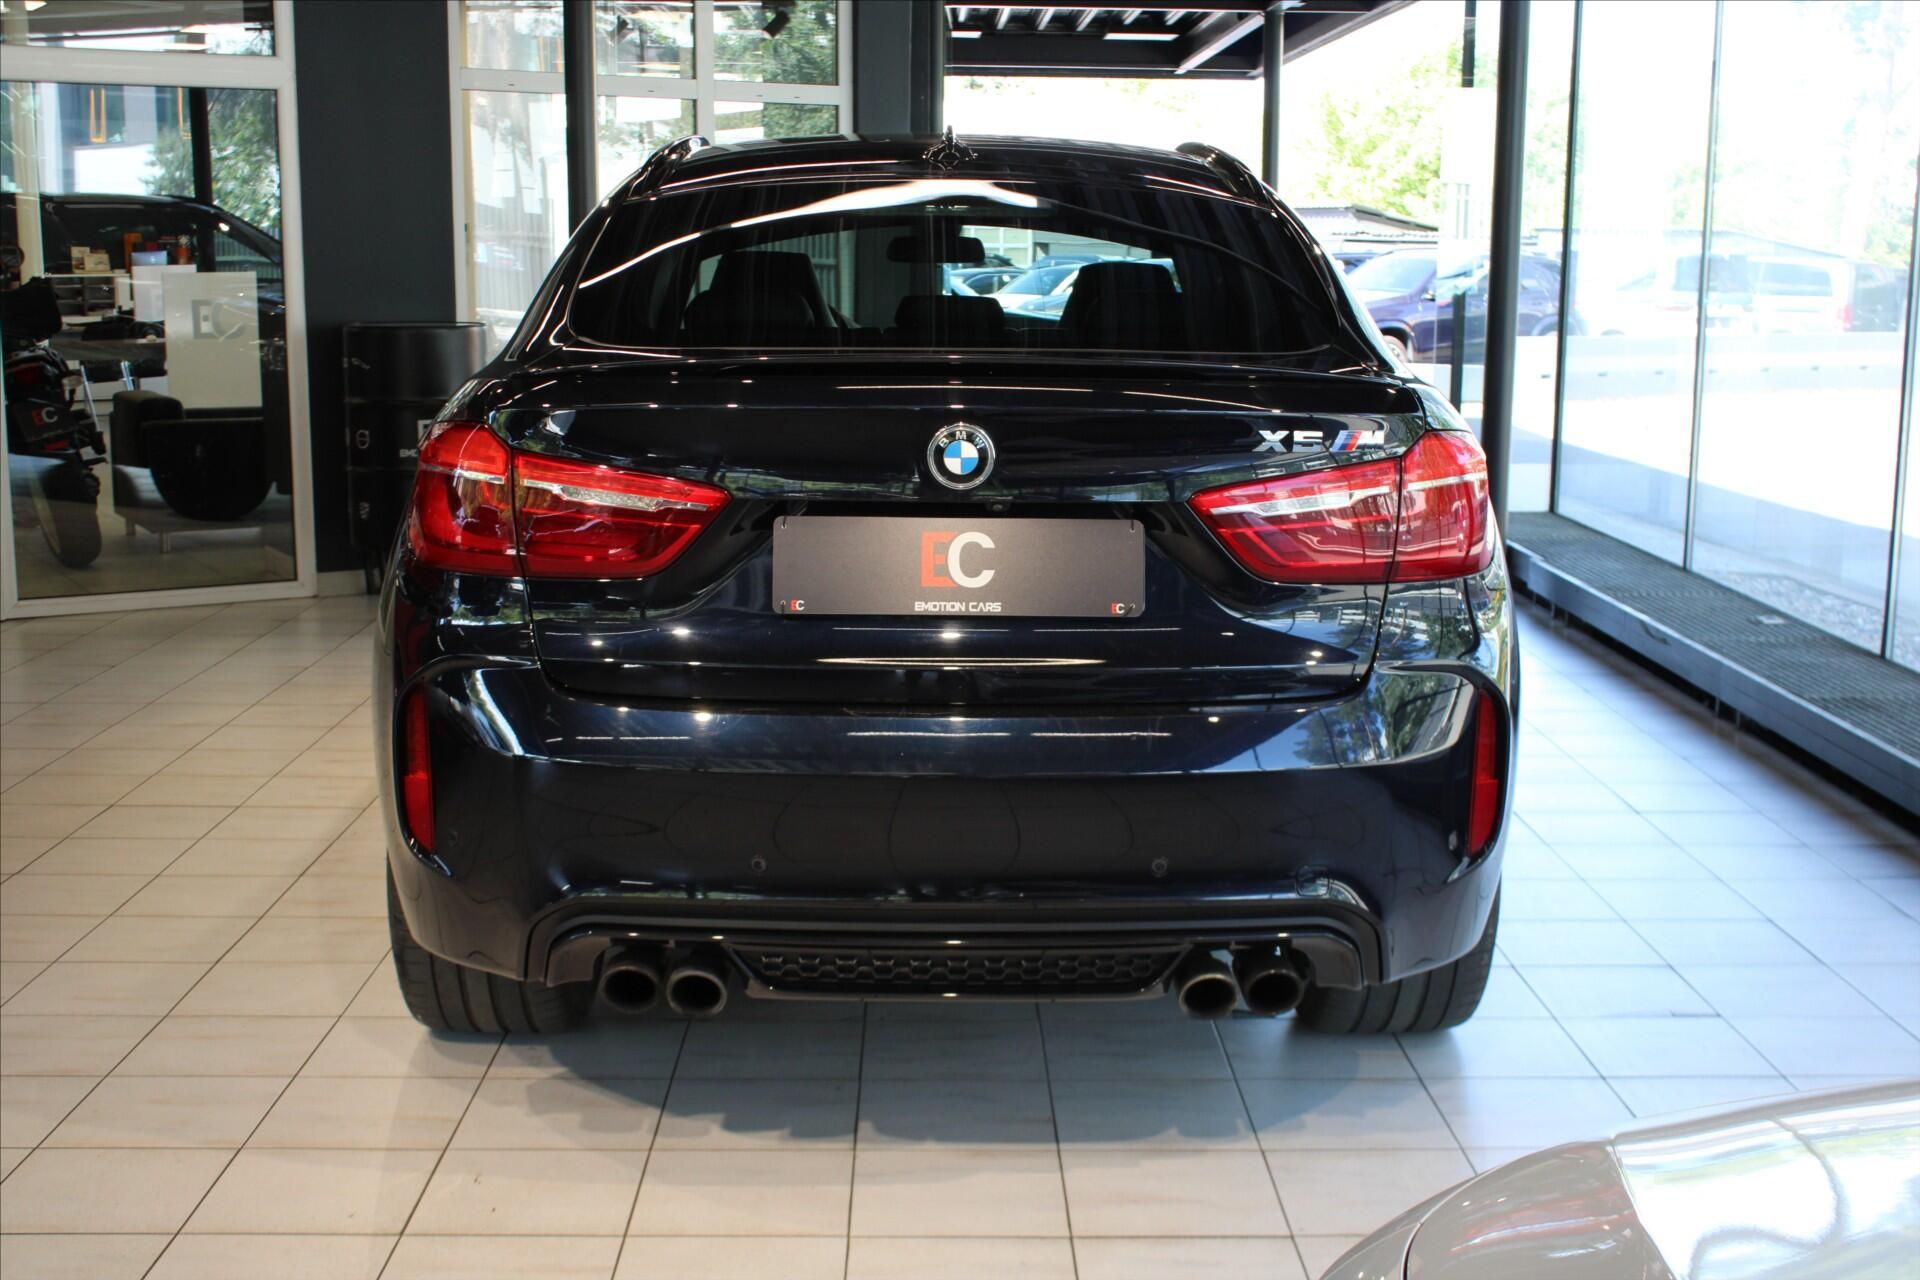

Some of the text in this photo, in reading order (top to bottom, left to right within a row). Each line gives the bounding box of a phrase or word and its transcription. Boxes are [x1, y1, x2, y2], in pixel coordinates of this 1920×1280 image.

[938, 430, 986, 448] BMW
[920, 531, 996, 588] EC
[914, 601, 1002, 612] EMOTION CARS
